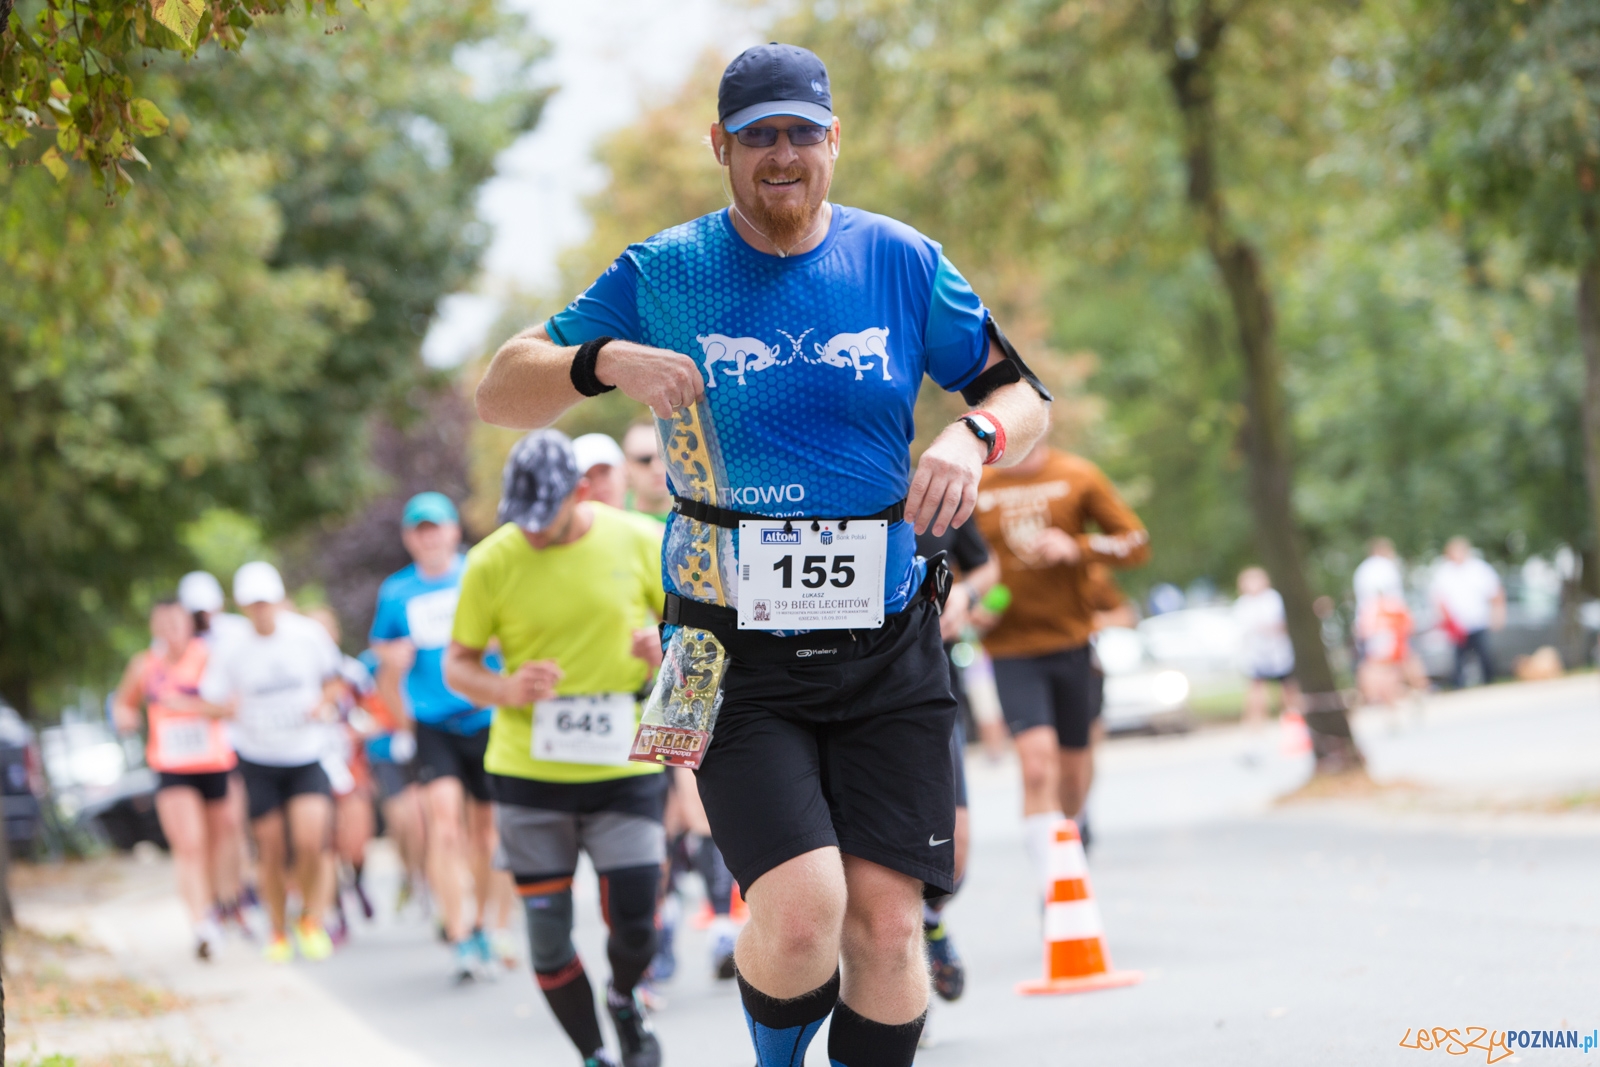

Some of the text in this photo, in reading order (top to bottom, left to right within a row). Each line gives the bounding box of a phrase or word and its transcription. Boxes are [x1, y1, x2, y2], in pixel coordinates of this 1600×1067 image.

[773, 554, 856, 589] 155
[774, 596, 871, 610] 39 BIEG LECHITÓW
[556, 711, 612, 736] 645
